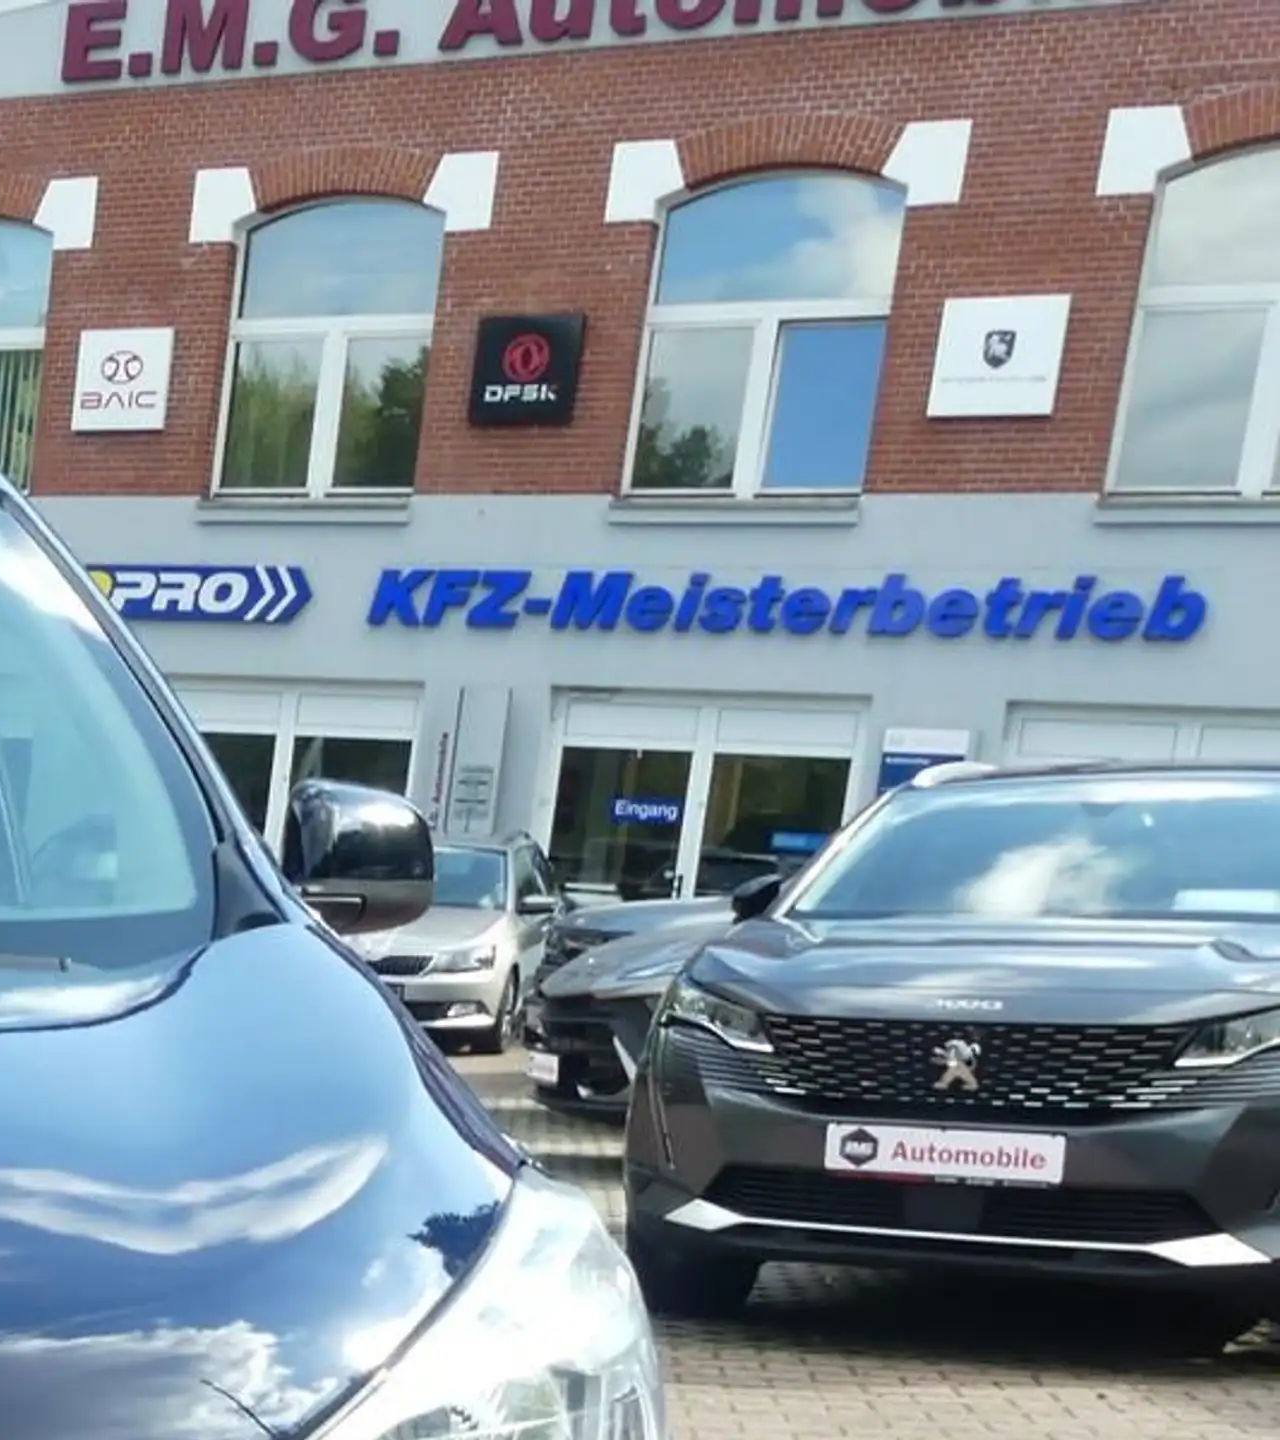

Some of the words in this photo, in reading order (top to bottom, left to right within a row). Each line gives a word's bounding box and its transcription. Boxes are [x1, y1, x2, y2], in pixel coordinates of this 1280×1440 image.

[61, 0, 400, 83] E.M.G.
[80, 391, 157, 410] BAIC
[366, 569, 1208, 642] KFZ-Meisterbetrieb
[614, 799, 678, 822] Eingang
[891, 1141, 1047, 1170] Automobile
